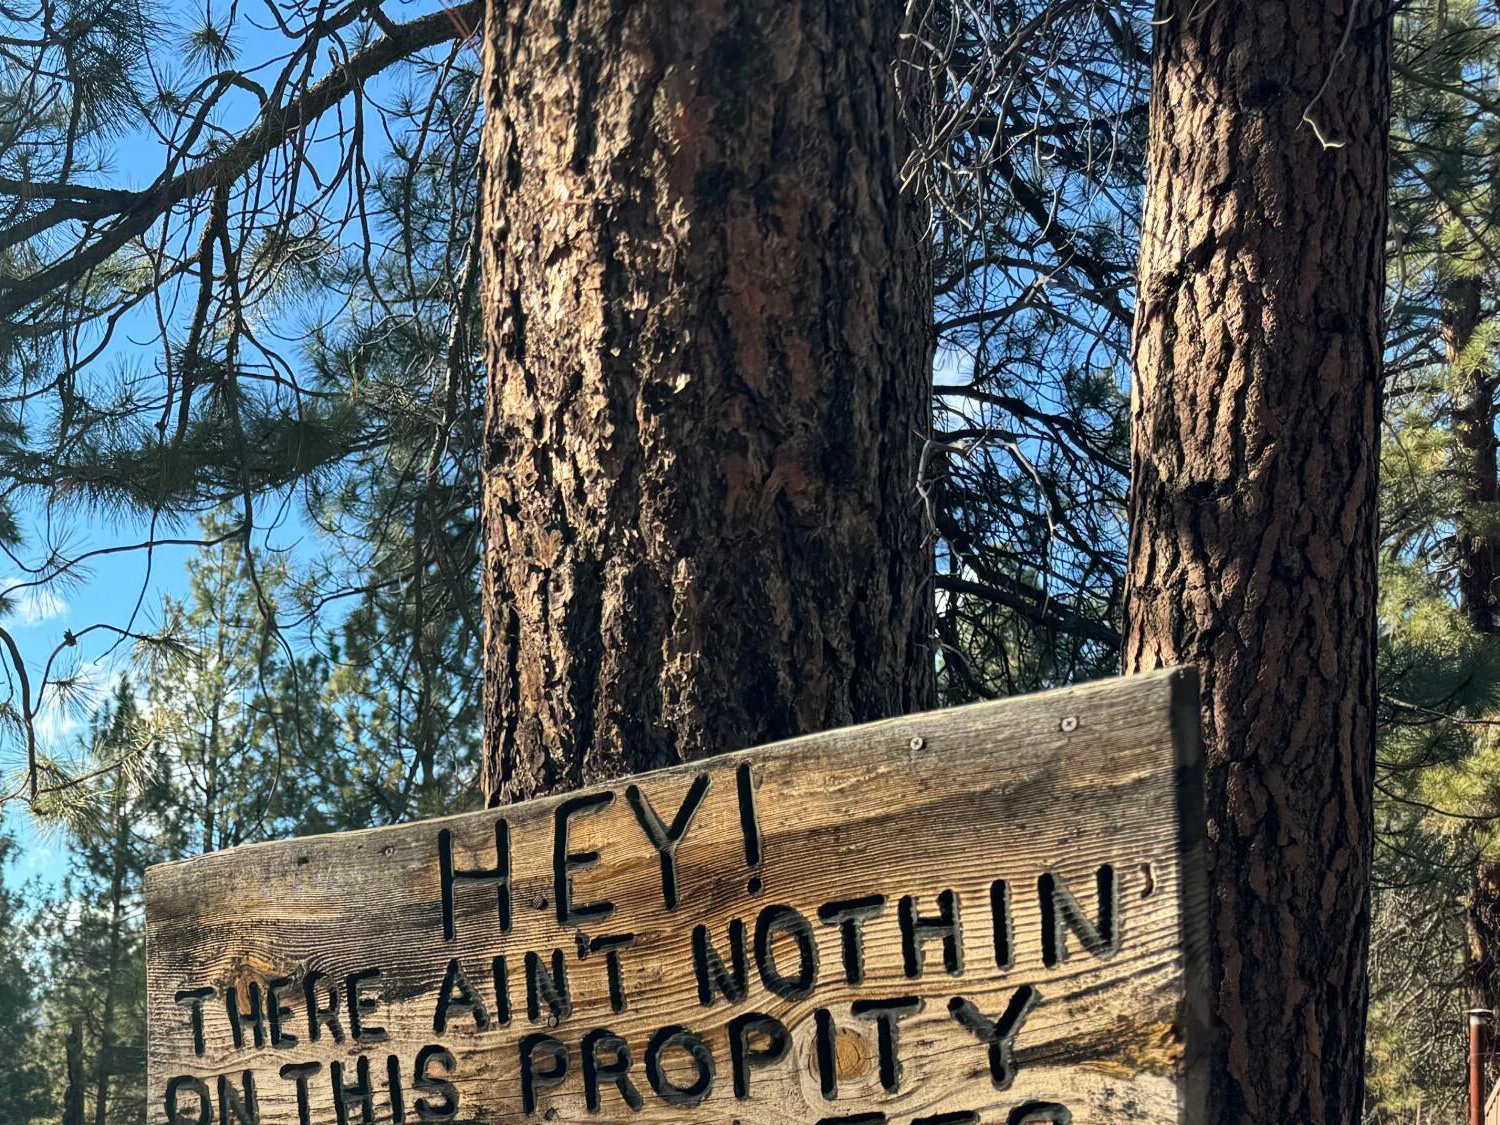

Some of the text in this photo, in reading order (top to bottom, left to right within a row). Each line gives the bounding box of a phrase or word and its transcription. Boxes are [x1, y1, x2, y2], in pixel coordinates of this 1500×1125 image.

[437, 763, 765, 941] HEY!
[174, 861, 1157, 1057] THERE AIN'T NOTHIN'
[519, 984, 1044, 1117] PROPITY
